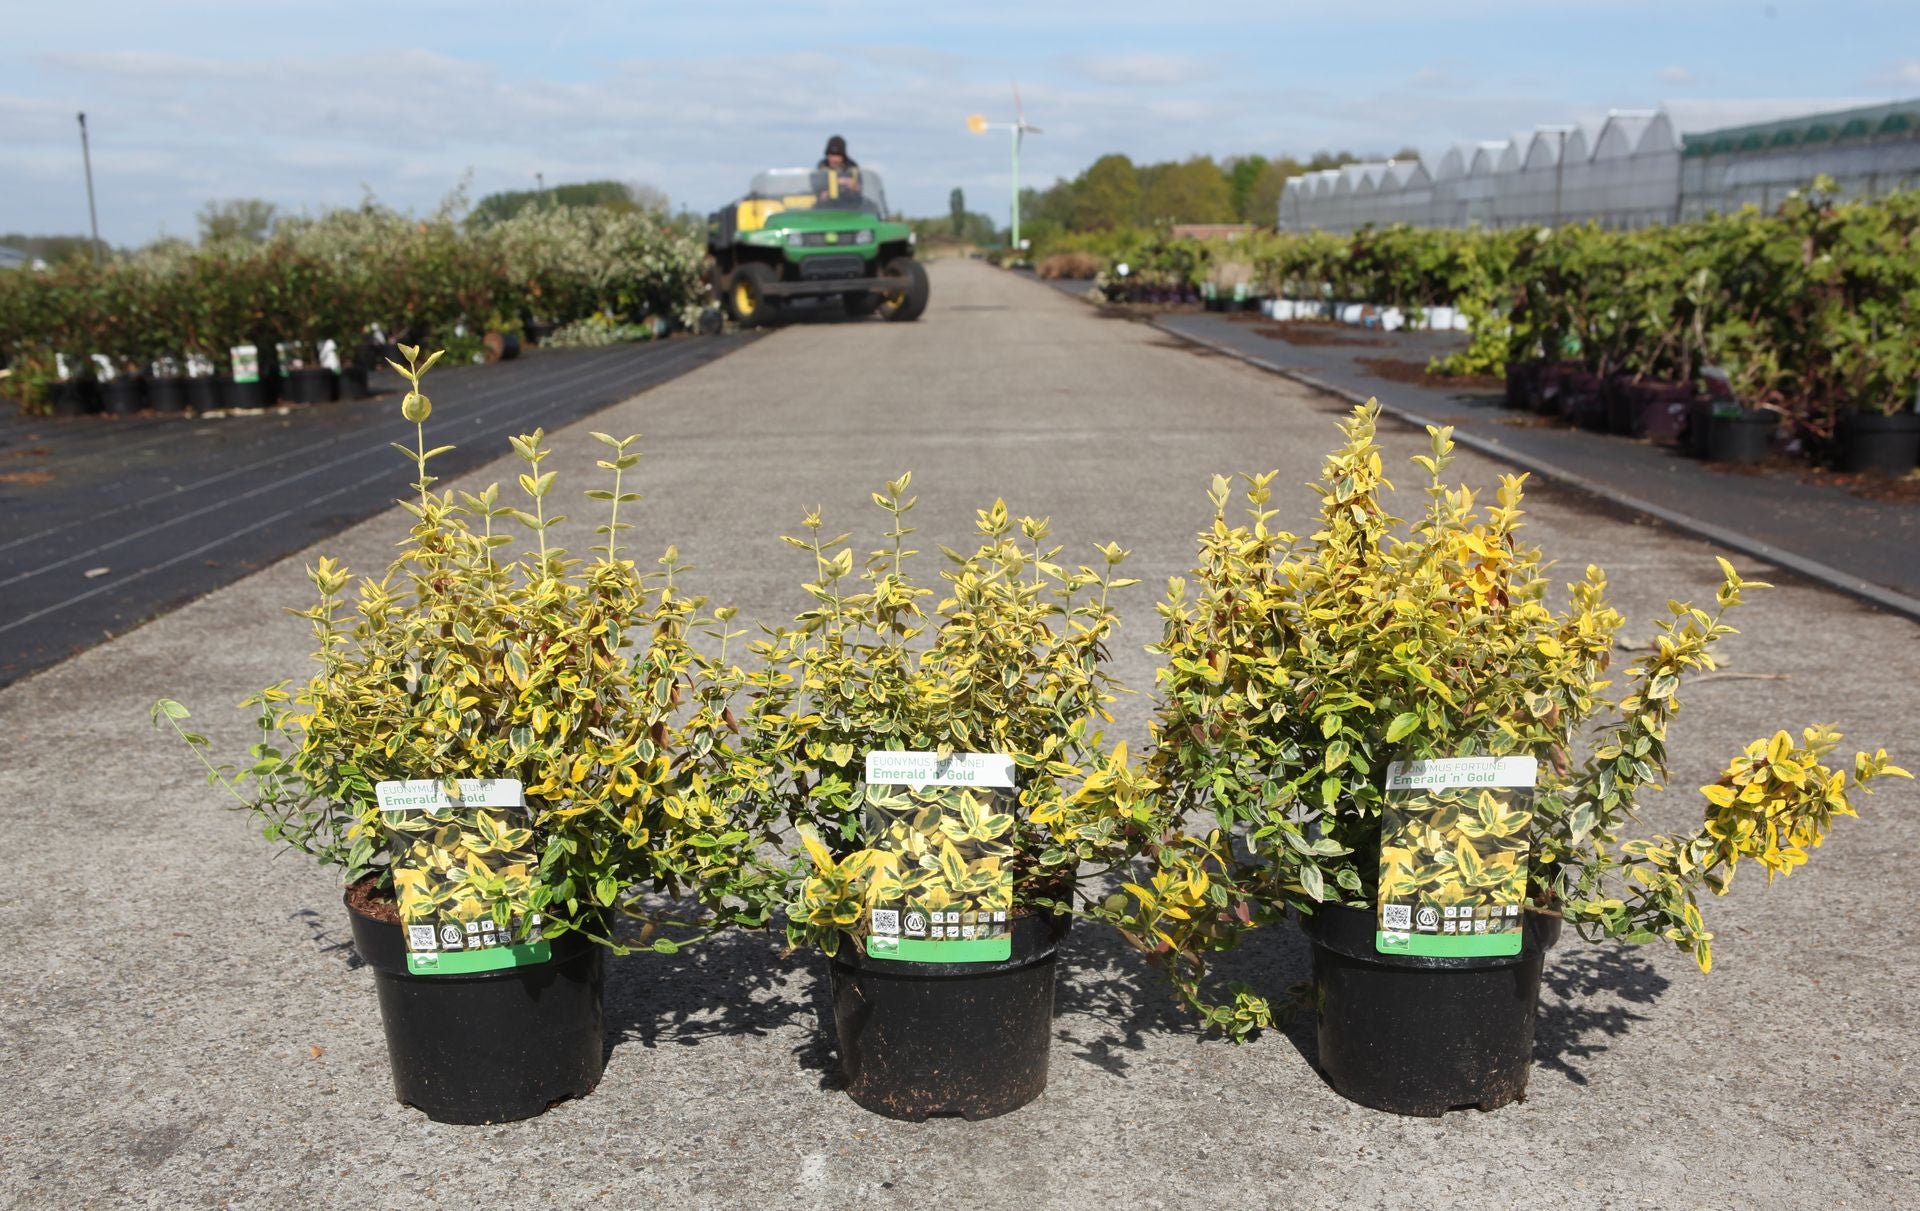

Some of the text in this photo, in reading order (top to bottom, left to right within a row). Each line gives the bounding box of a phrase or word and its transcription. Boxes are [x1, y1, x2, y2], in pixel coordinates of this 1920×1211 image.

[873, 768, 926, 780] Emerald
[947, 770, 975, 781] Gold
[1395, 762, 1506, 775] EONYMUS FORTUNEI
[1393, 774, 1446, 785] Emerald
[1467, 772, 1495, 782] Gold
[385, 795, 438, 806] Emerald
[460, 794, 486, 803] Gold
